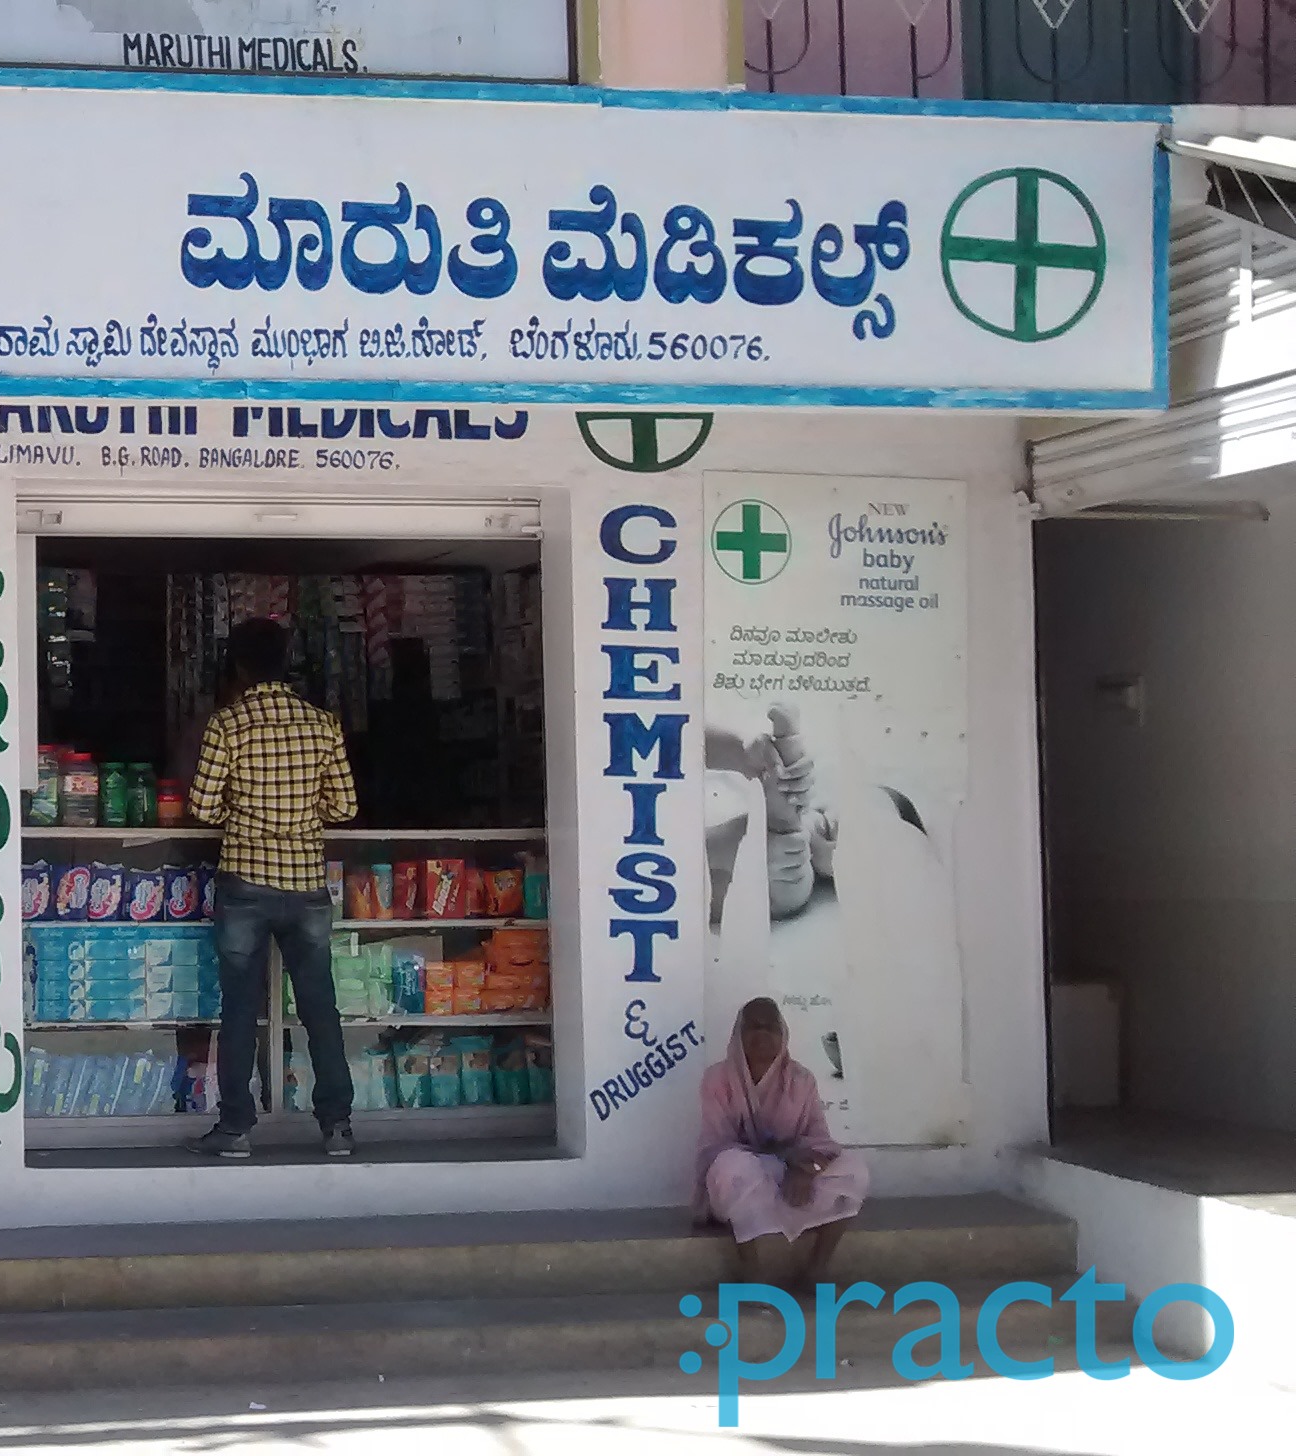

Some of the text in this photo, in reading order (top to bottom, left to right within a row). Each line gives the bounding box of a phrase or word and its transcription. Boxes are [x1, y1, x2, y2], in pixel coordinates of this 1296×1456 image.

[121, 32, 368, 75] MARUTHI MEDICALS.
[180, 171, 911, 341] ಮಾರುತಿ ಮೆಡಿಕಲ್ಸ್
[867, 502, 909, 516] NEW
[828, 511, 949, 560] Johnson's
[862, 547, 915, 574] baby
[840, 592, 939, 613] massage oil
[858, 574, 920, 592] natural
[599, 503, 691, 984] CHEMIST
[588, 1018, 707, 1123] DRUGGIST.
